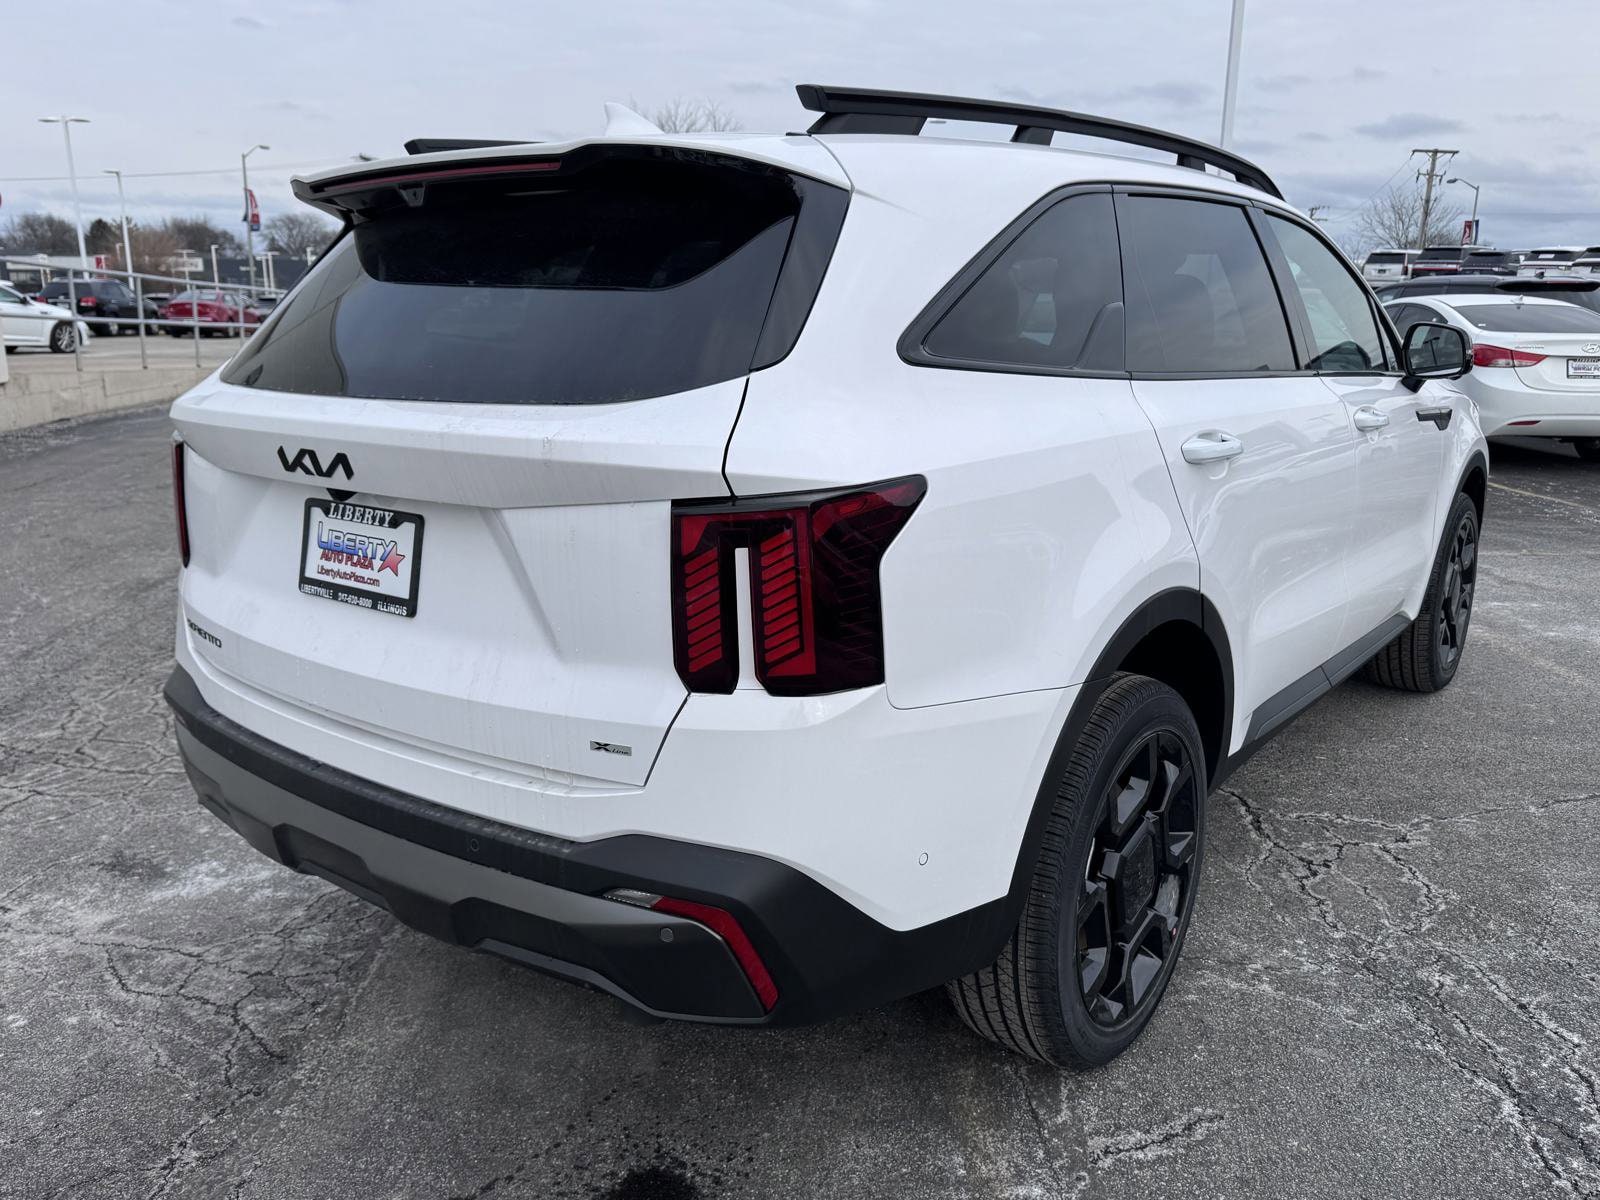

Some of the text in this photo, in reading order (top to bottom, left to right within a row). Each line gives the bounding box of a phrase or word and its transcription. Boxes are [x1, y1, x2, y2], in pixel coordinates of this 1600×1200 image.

[328, 502, 395, 528] LIBERTY
[317, 520, 398, 562] LIBERTY
[320, 548, 375, 571] AUTO PLAZA
[377, 600, 408, 616] ILLINOIS
